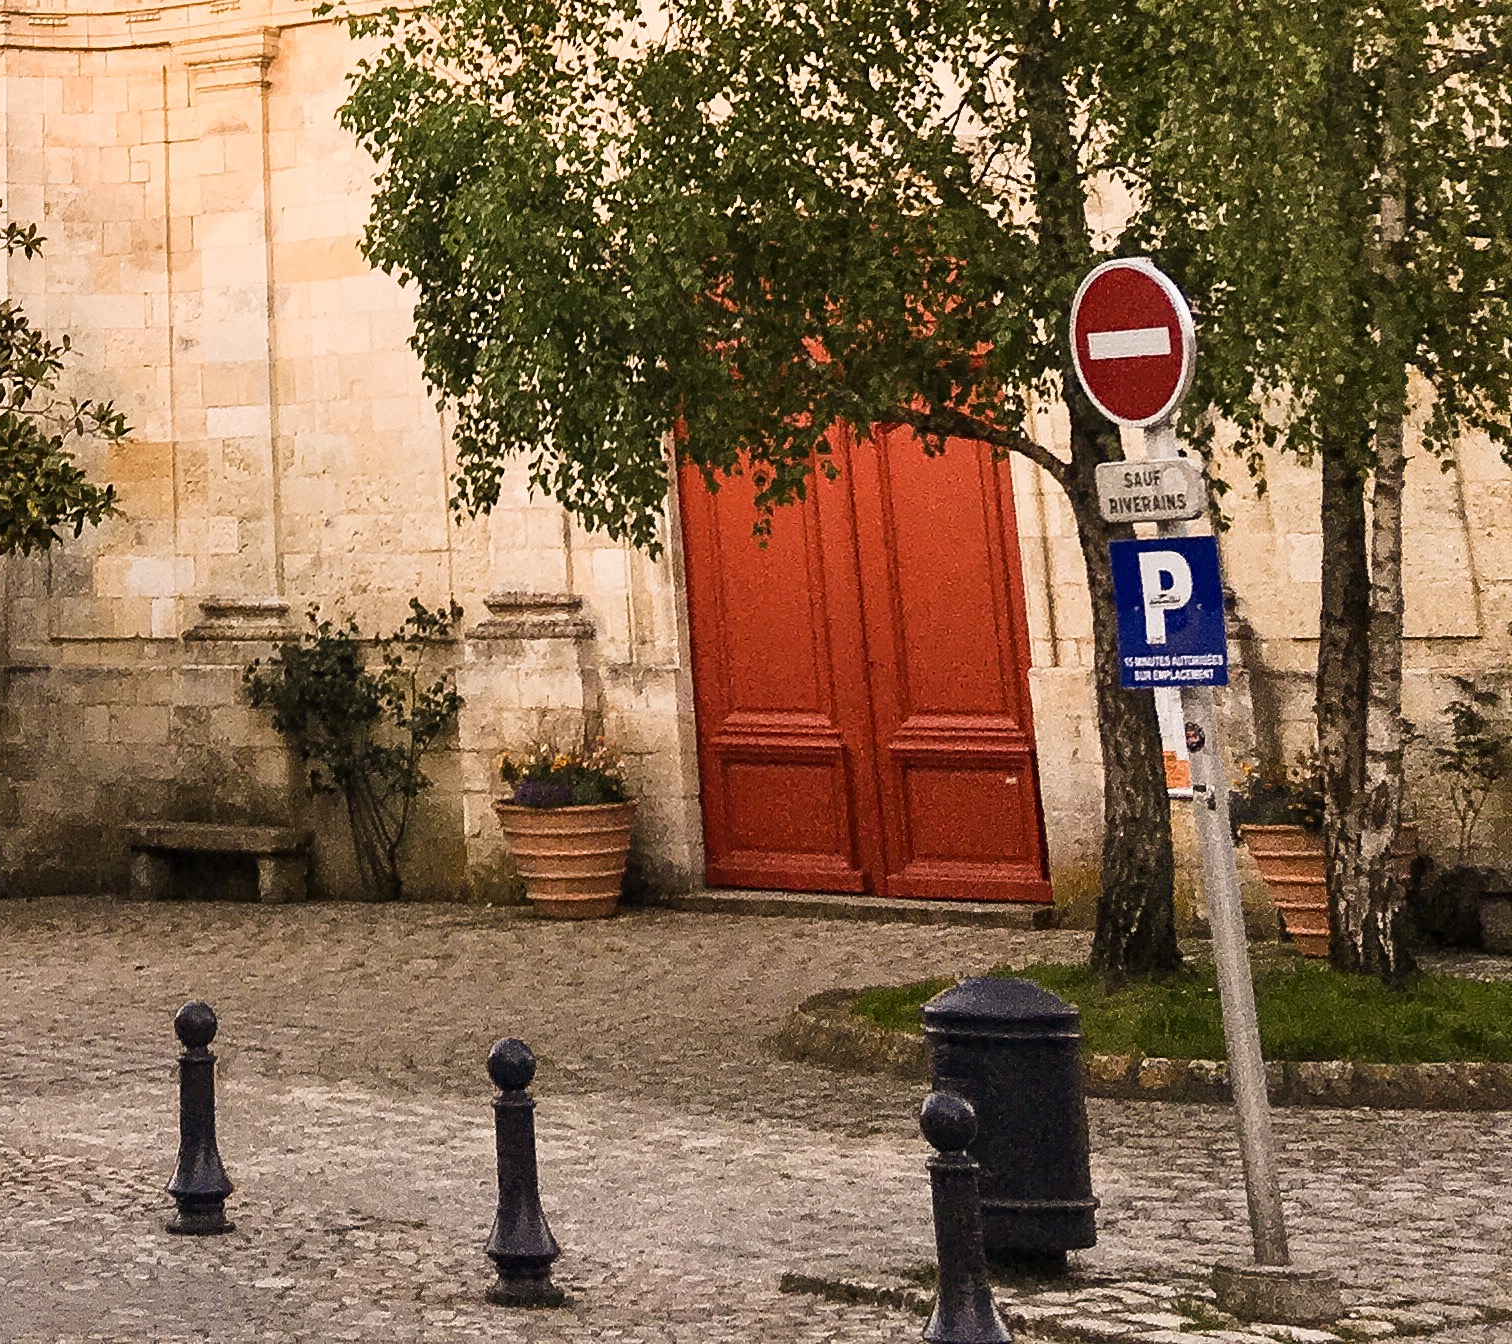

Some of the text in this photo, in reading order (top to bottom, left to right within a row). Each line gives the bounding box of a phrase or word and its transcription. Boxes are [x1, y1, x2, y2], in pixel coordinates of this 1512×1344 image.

[1124, 470, 1160, 488] SAUF
[1108, 493, 1187, 514] RIVERAINS
[1138, 551, 1193, 645] P
